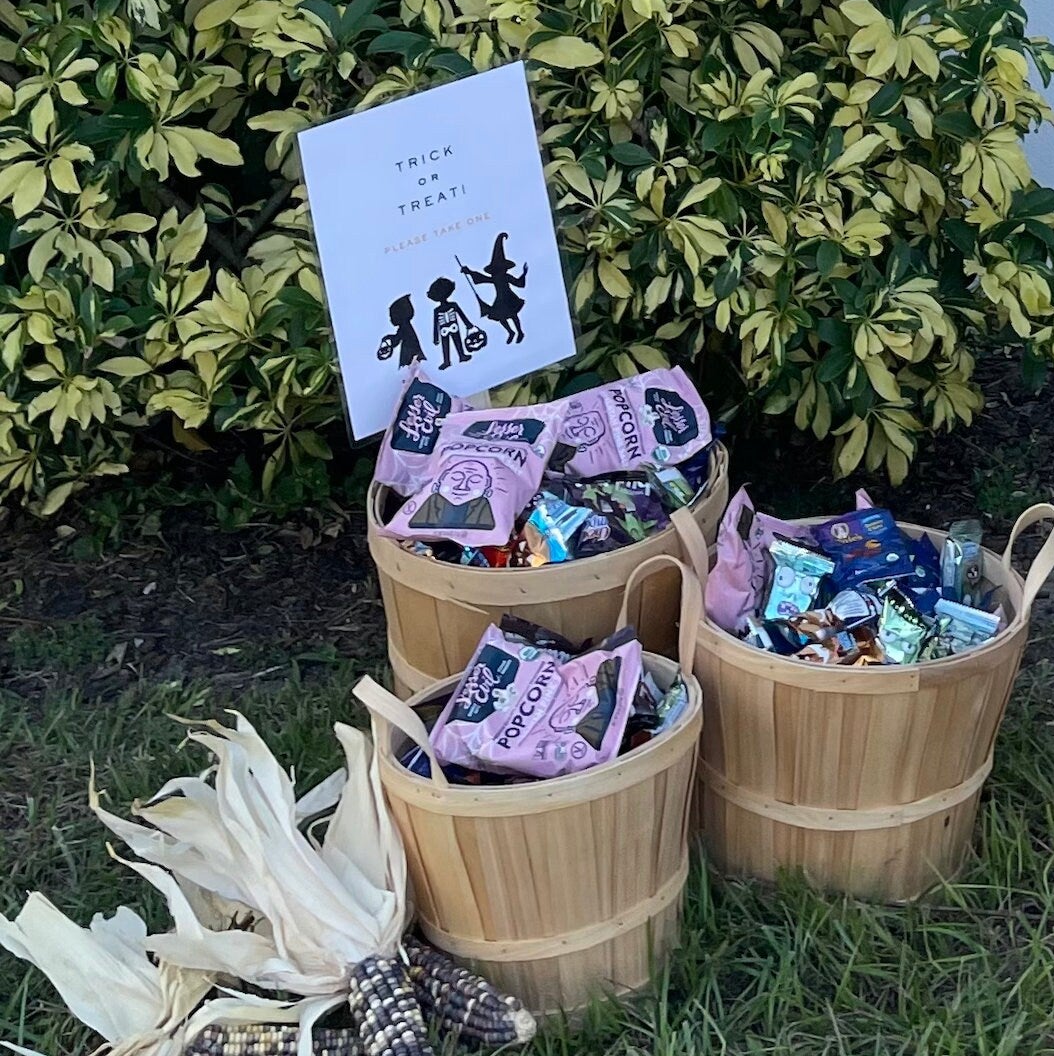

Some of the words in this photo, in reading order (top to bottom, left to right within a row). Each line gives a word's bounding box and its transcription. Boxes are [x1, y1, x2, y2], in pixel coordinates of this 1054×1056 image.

[395, 145, 454, 172] TRICK
[418, 173, 439, 186] OR
[384, 233, 428, 254] PLEASE
[433, 222, 462, 238] TAKE
[466, 212, 492, 226] ONE
[608, 389, 642, 461] POPCORN
[473, 666, 502, 704] Evil
[497, 661, 557, 749] POPCORN
